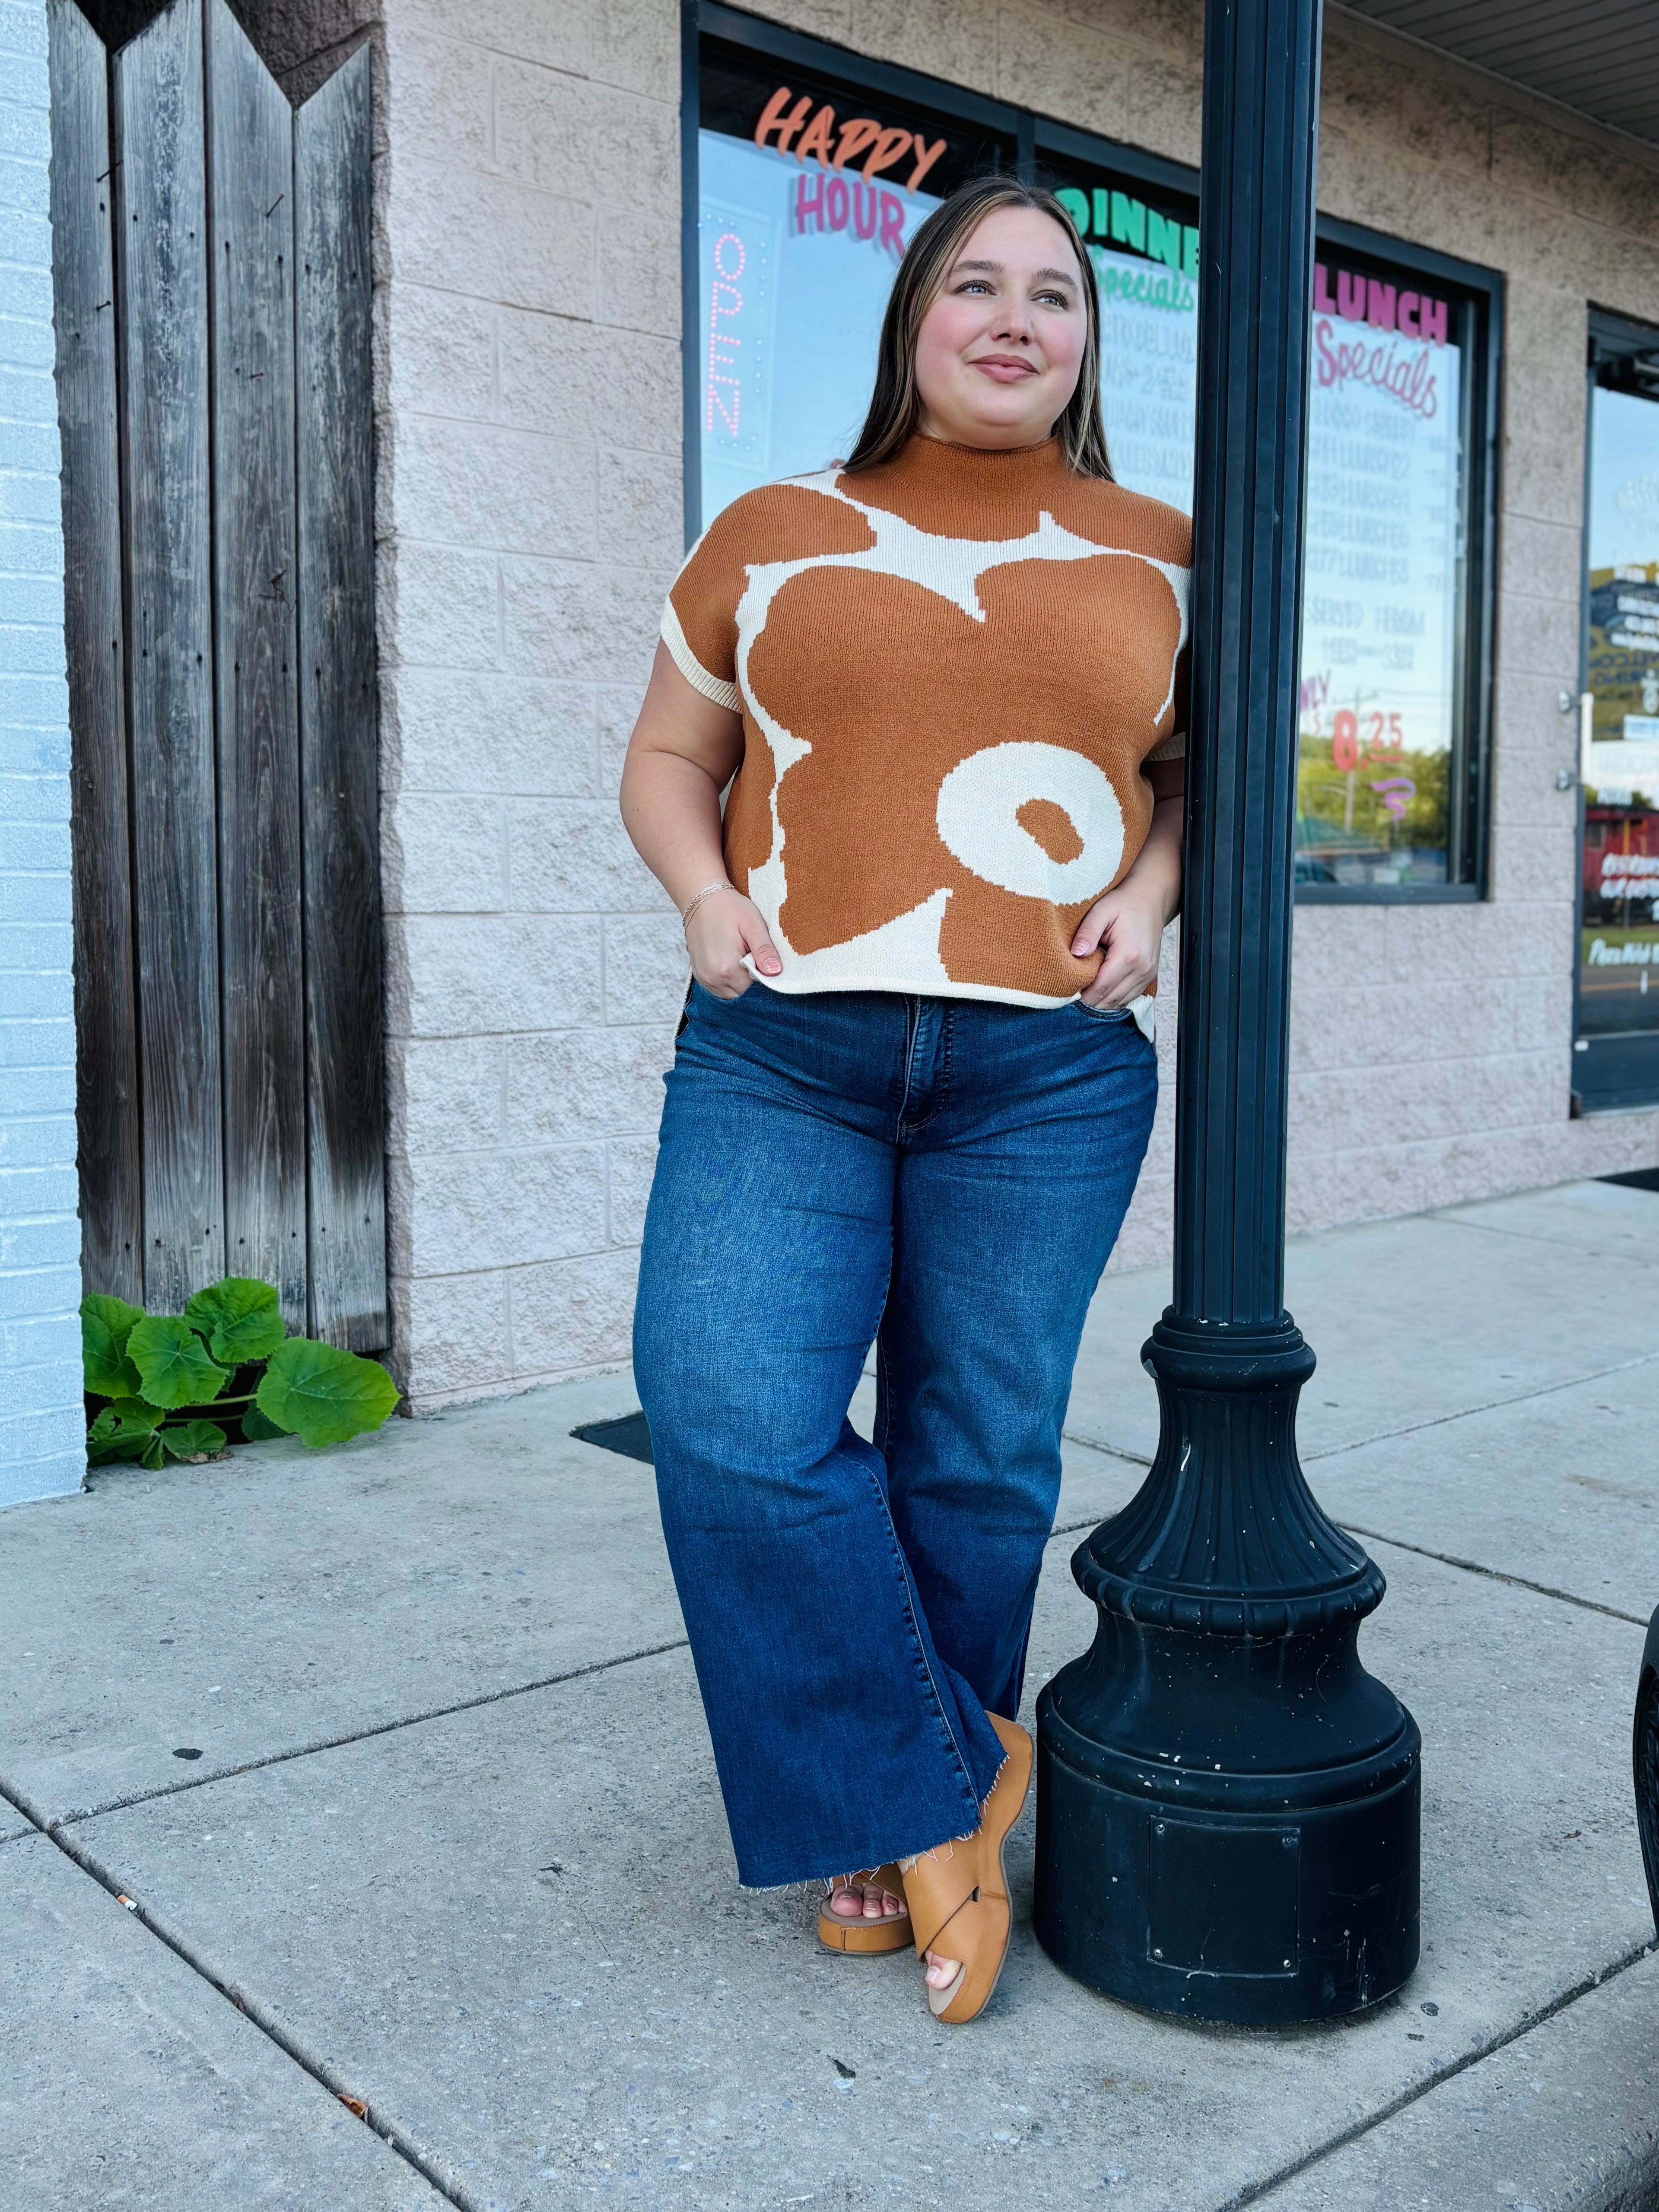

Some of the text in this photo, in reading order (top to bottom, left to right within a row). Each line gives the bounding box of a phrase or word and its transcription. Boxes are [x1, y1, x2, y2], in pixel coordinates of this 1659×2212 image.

[754, 86, 947, 194] HAPPY
[796, 173, 906, 258] HOUR
[1053, 188, 1199, 280] DINNE
[707, 233, 746, 438] OPEN
[1314, 263, 1448, 347] LUNCH
[1316, 319, 1437, 418] Specials
